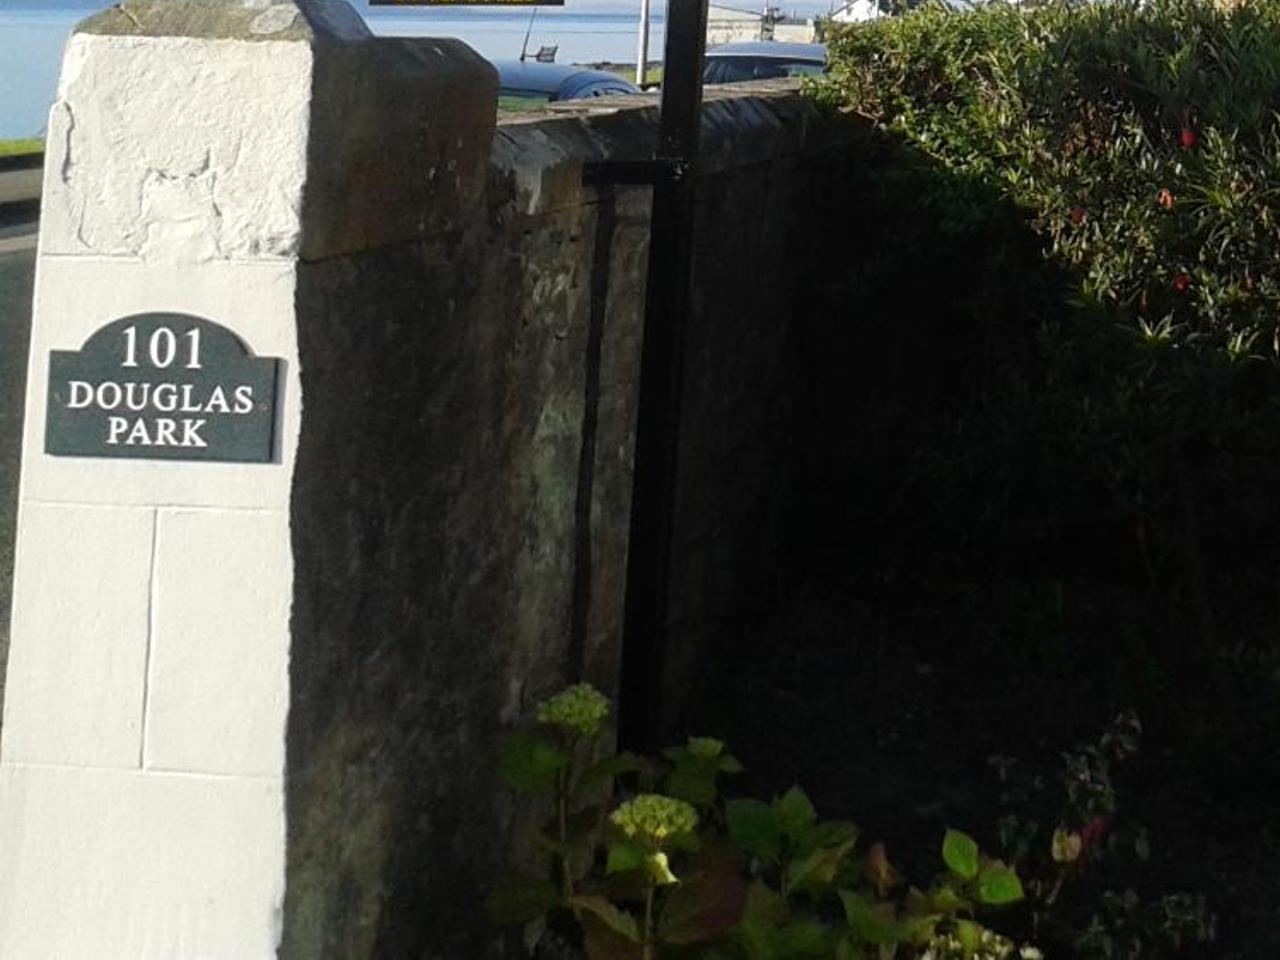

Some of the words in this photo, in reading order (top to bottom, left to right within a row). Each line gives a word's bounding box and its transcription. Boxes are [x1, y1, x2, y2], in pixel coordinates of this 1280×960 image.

[121, 326, 203, 369] 101
[67, 381, 253, 414] DOUGLAS
[106, 416, 208, 447] PARK
